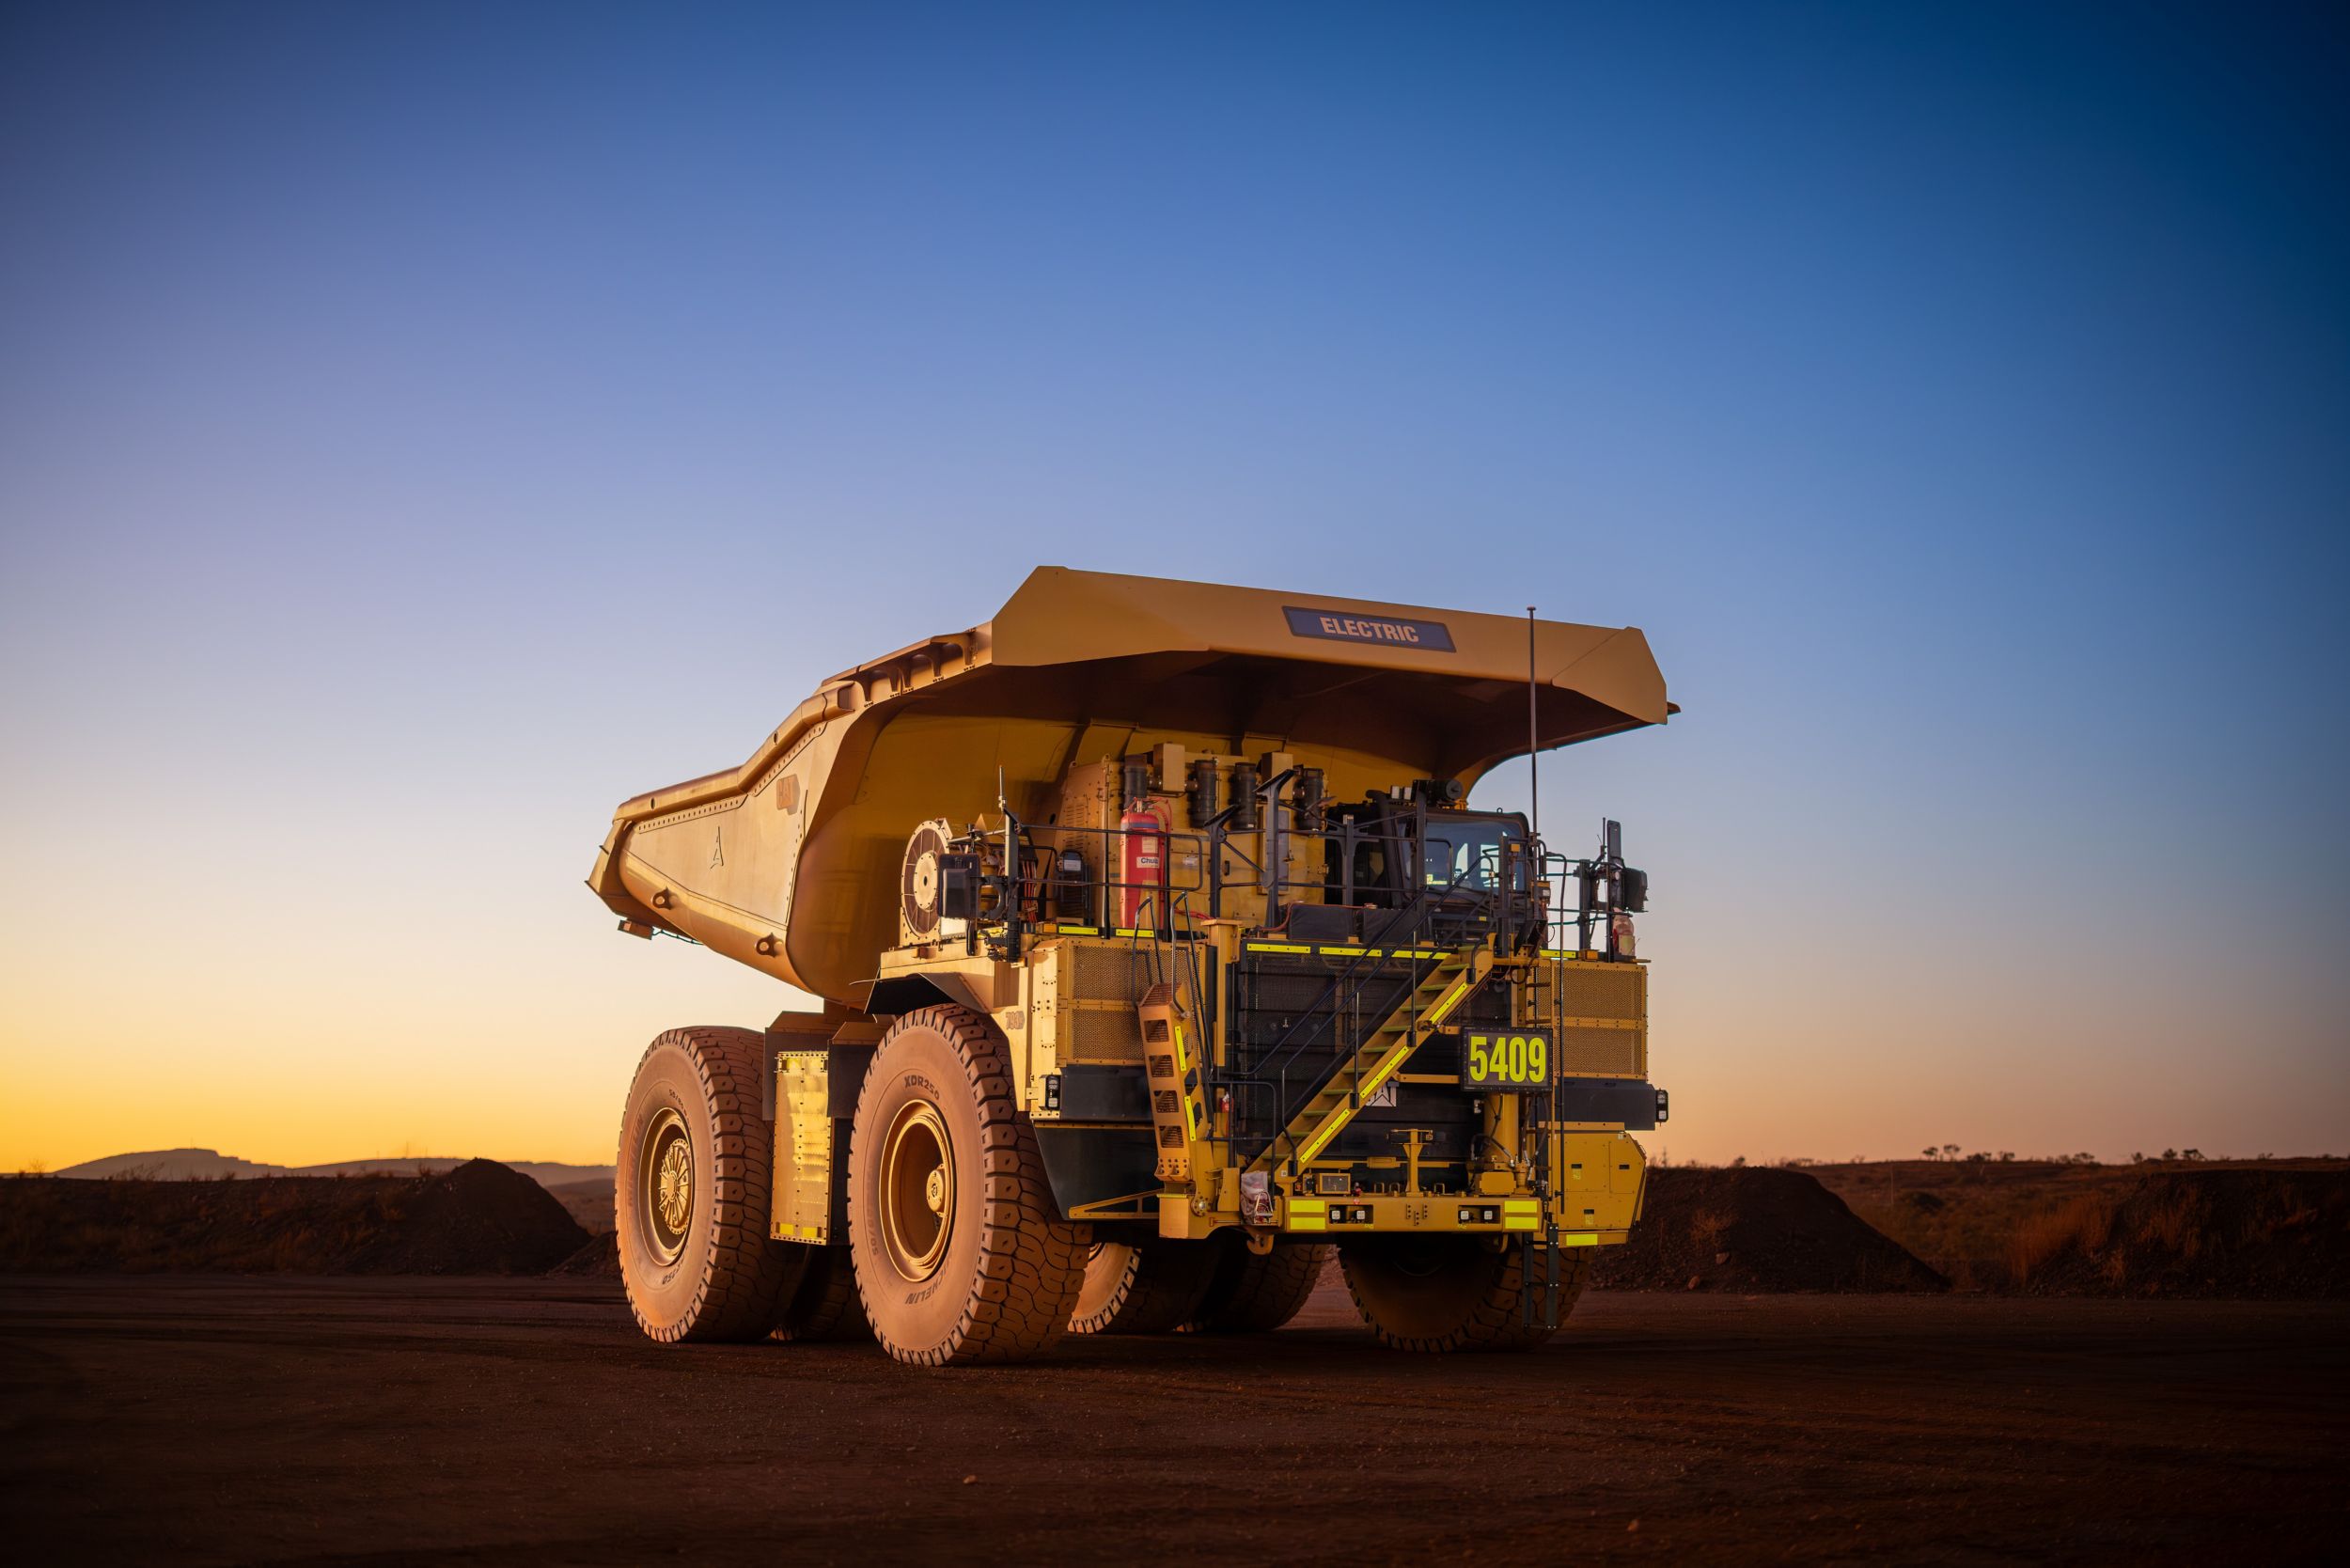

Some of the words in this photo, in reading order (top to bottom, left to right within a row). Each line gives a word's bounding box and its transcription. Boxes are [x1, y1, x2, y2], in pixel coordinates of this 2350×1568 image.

[1320, 616, 1419, 643] ELECTRIC
[1469, 1036, 1546, 1083] 5409
[904, 1074, 940, 1101] XDR250
